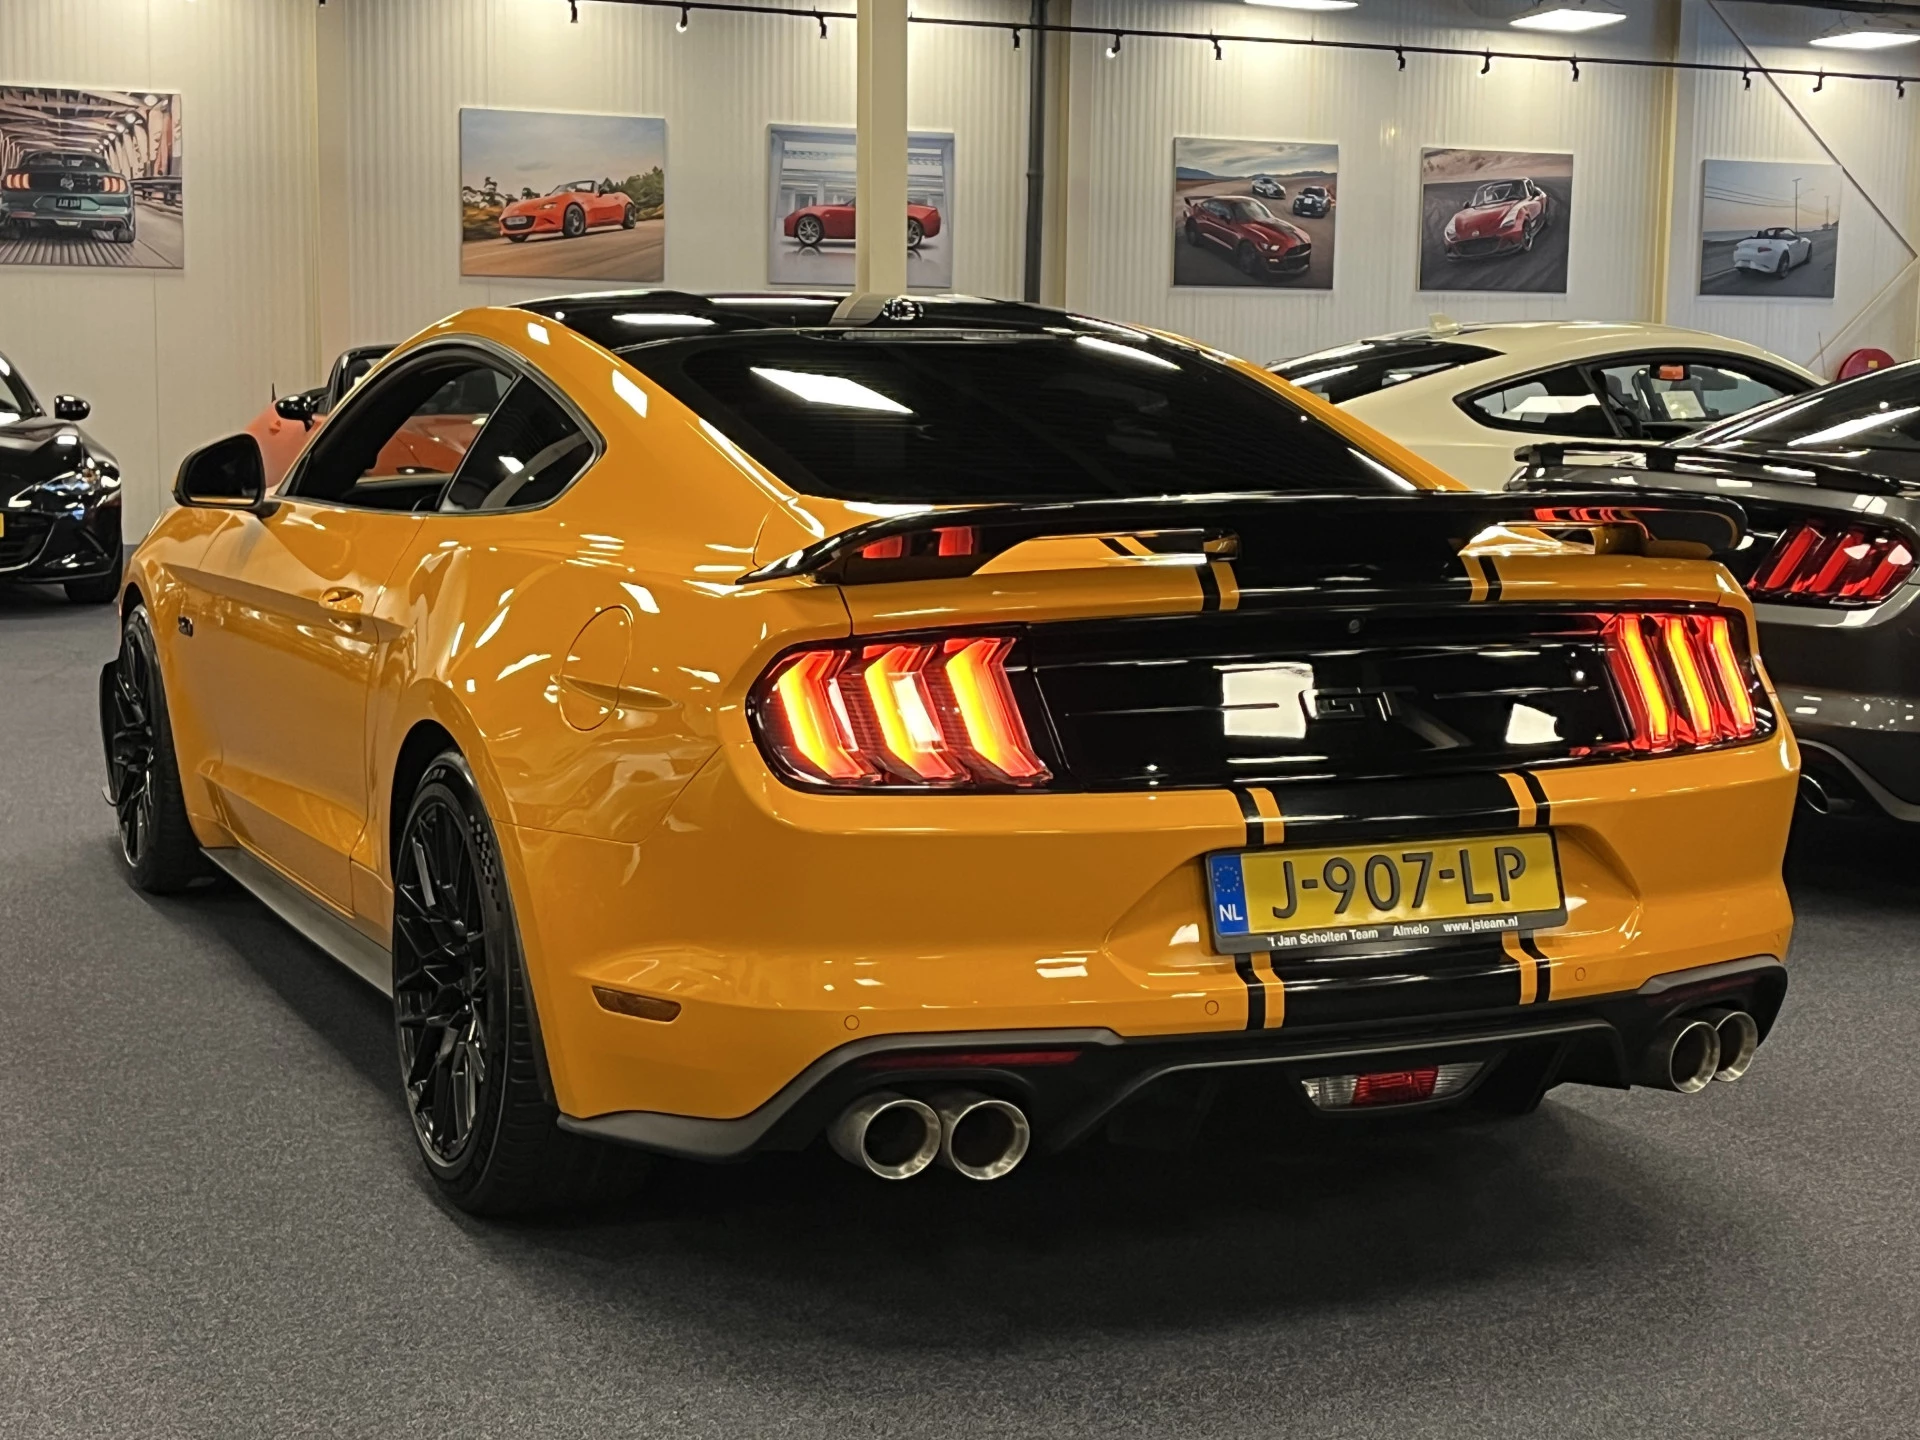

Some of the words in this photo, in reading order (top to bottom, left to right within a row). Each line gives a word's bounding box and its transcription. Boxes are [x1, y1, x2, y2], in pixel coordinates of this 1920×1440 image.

[1272, 846, 1527, 919] J-907-LP
[1219, 903, 1243, 922] NL
[1277, 934, 1298, 947] Jan
[1299, 931, 1348, 945] Scholten
[1349, 928, 1379, 941] Team
[1393, 923, 1430, 937] Almelo
[1442, 915, 1519, 933] www.jsteam.nl
